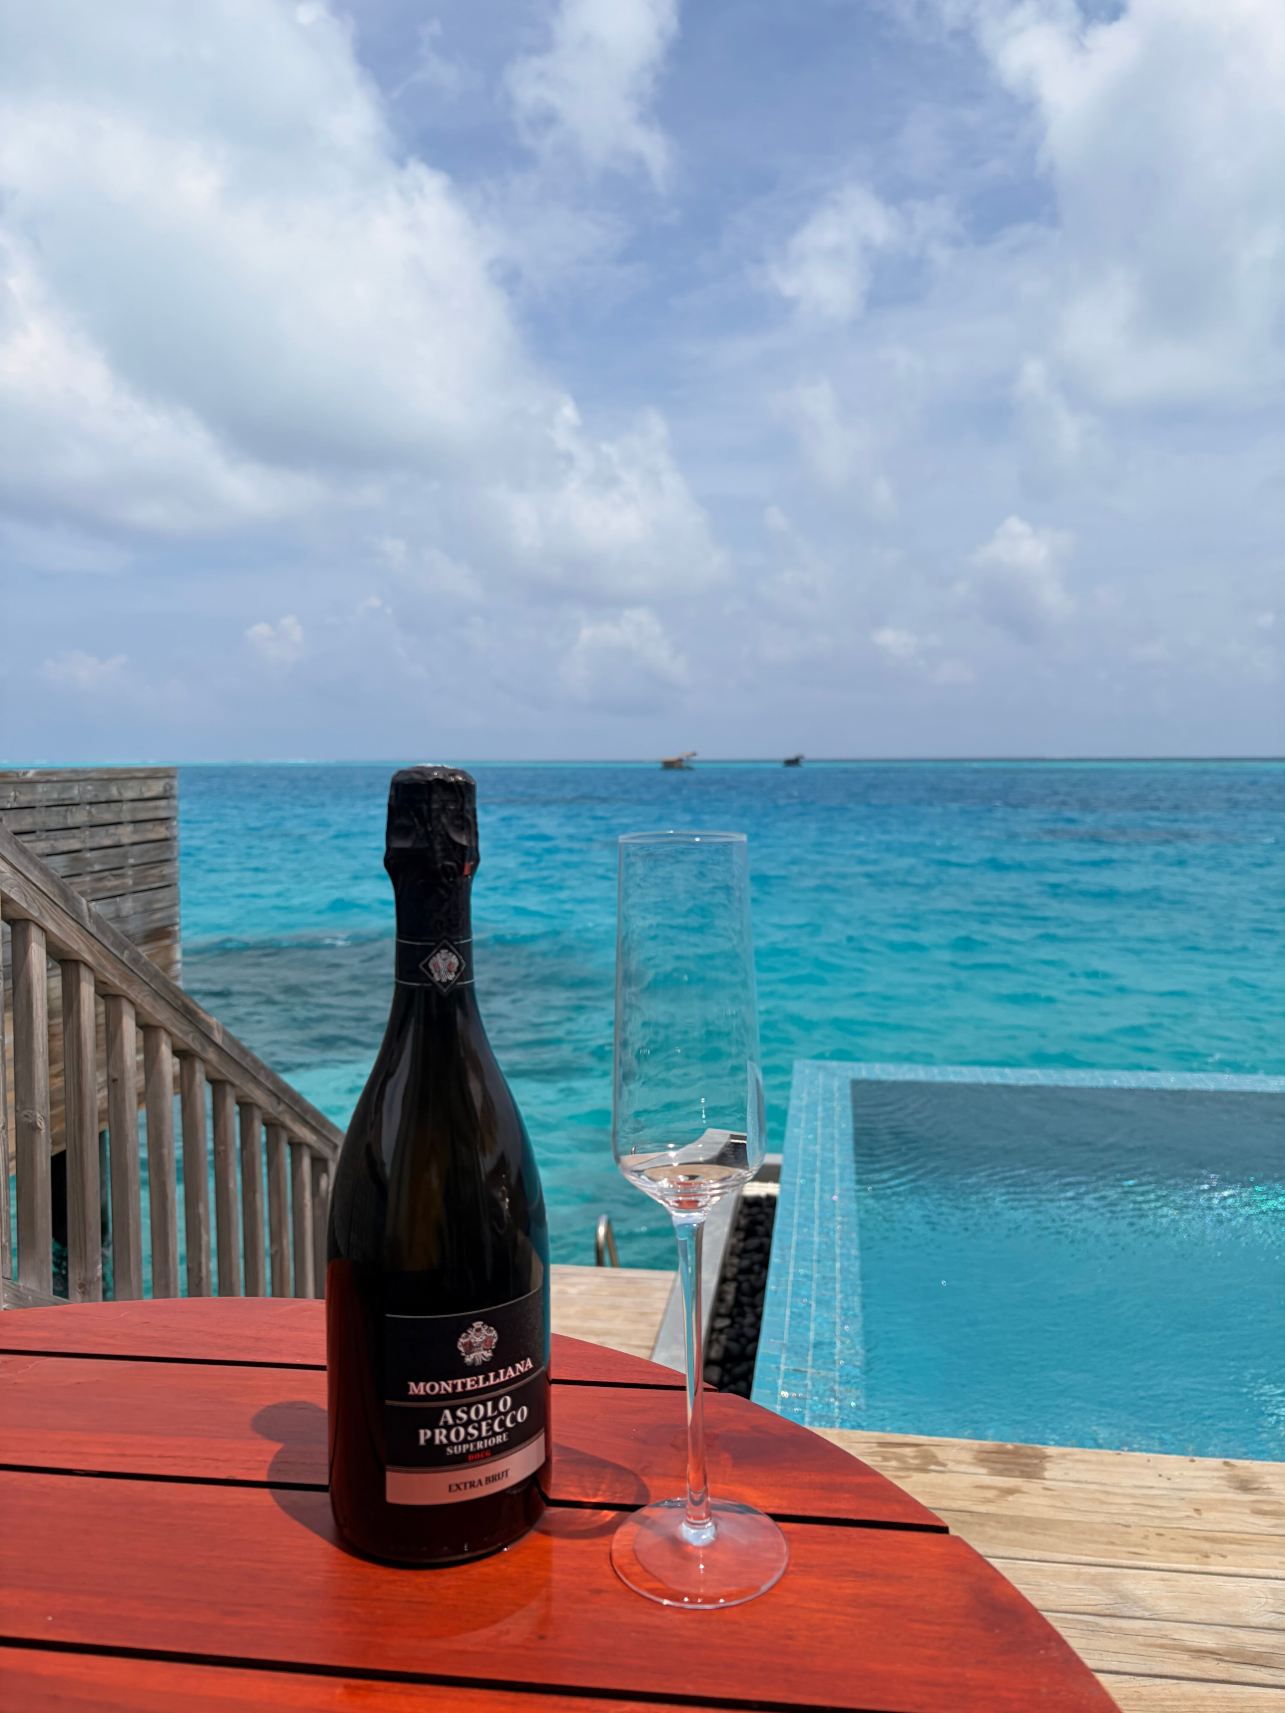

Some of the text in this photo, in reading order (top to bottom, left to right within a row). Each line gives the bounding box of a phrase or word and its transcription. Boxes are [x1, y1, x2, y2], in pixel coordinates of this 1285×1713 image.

[408, 1357, 533, 1395] MONTELLIANA
[418, 1405, 528, 1446] PROSECCO
[439, 1395, 512, 1427] ASOLO
[446, 1433, 509, 1456] SUPERIORE
[448, 1469, 510, 1493] EXTRA BRUT
